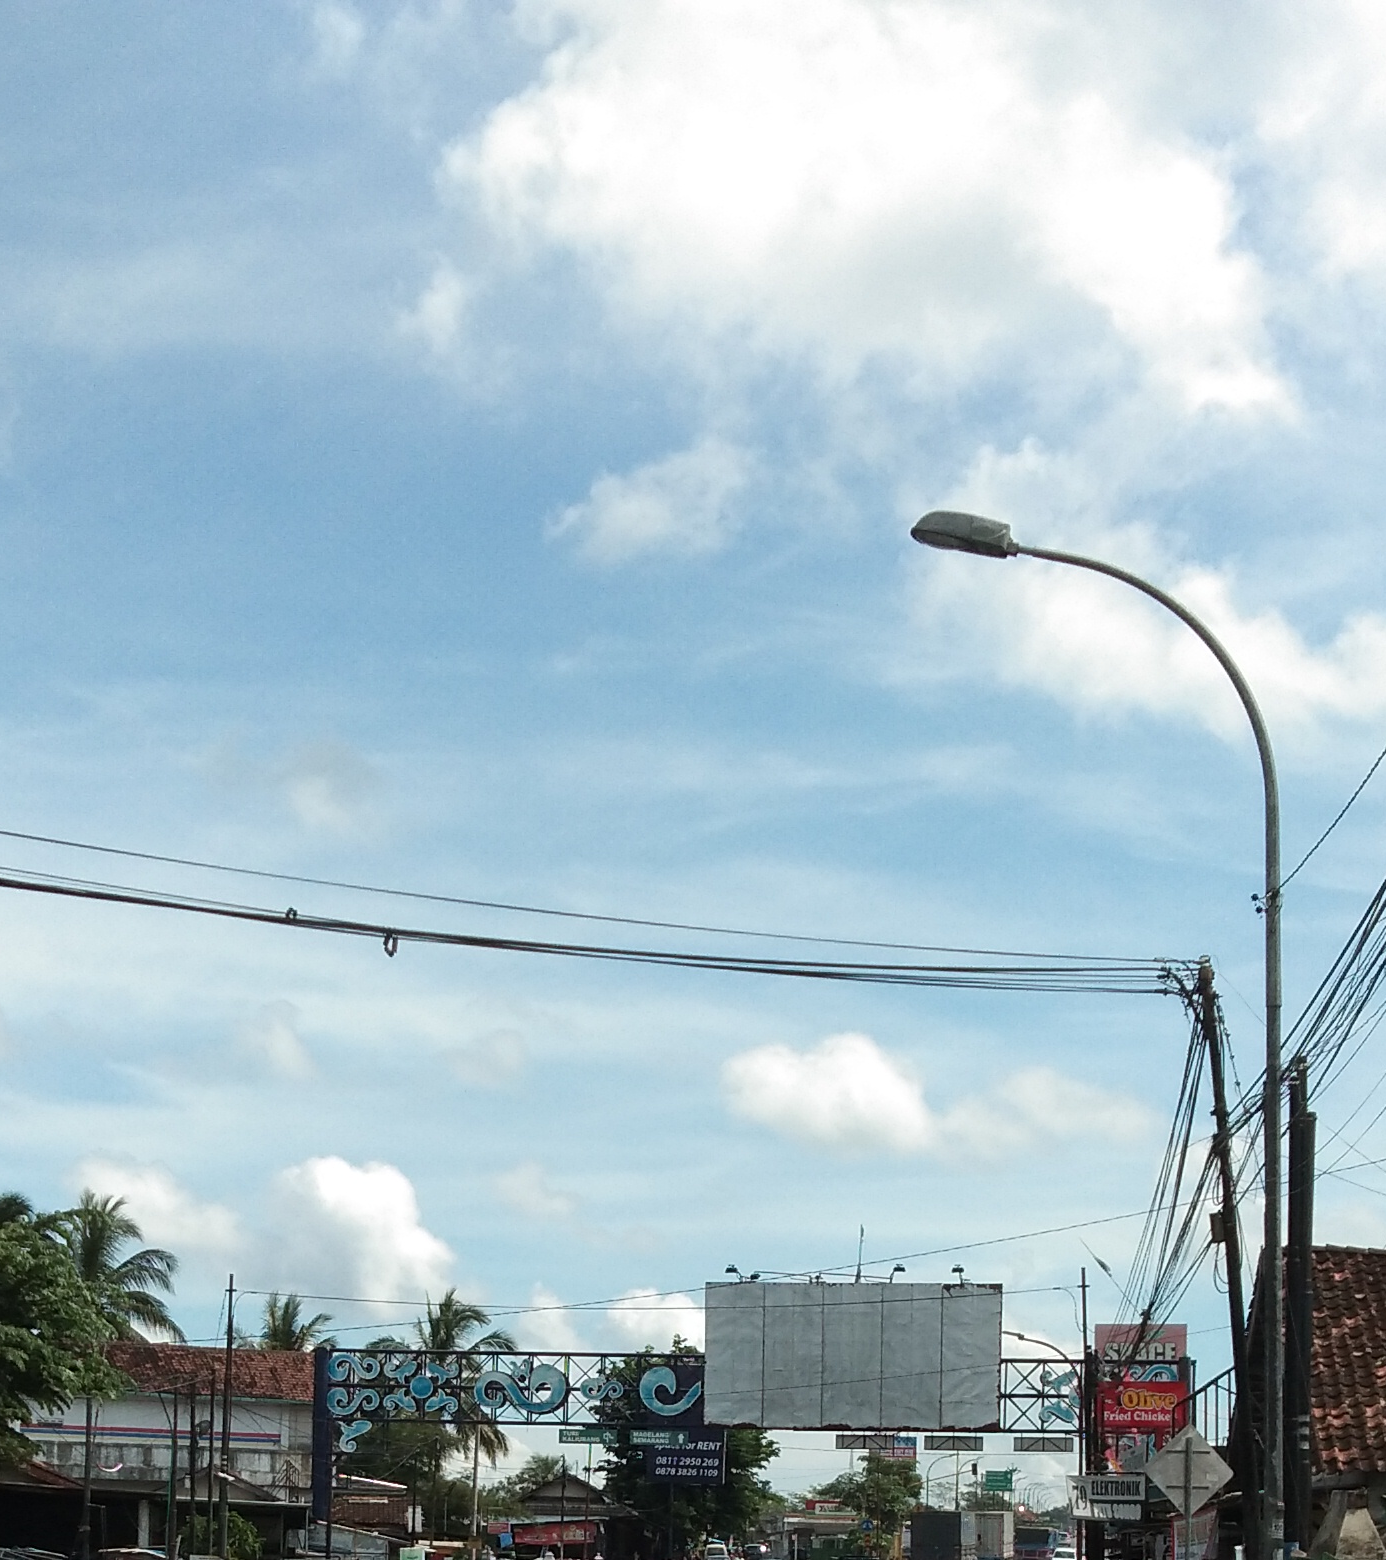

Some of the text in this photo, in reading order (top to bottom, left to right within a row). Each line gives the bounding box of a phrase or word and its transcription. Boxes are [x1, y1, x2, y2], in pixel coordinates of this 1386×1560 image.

[1121, 1388, 1177, 1410] Olive
[1103, 1411, 1131, 1421] Fried
[697, 1442, 722, 1451] RENT
[655, 1457, 720, 1467] 0811 2950 269
[655, 1467, 719, 1478] 0878 3826 1109
[1091, 1480, 1141, 1497] ELEKTRONIK
